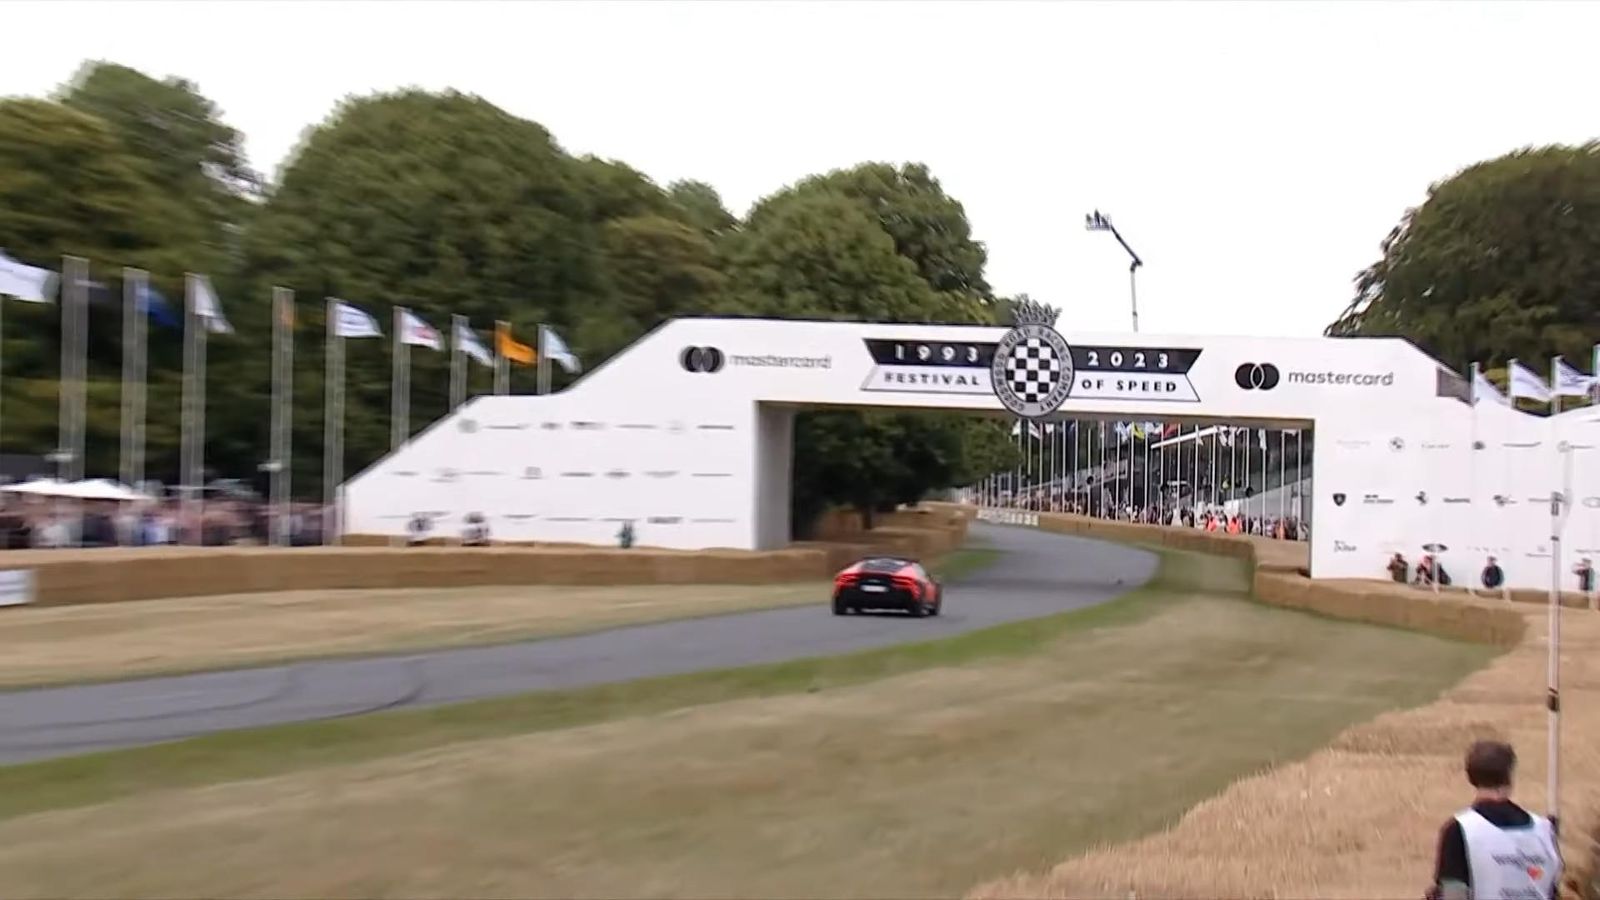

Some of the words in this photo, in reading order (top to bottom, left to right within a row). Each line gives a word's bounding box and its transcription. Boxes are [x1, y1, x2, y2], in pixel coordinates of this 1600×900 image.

[894, 344, 979, 362] 1993
[1087, 351, 1169, 369] 2023
[884, 371, 980, 386] FESTIVAL
[1081, 379, 1104, 390] OF
[1116, 379, 1177, 392] SPEED
[1288, 370, 1394, 386] mastercard
